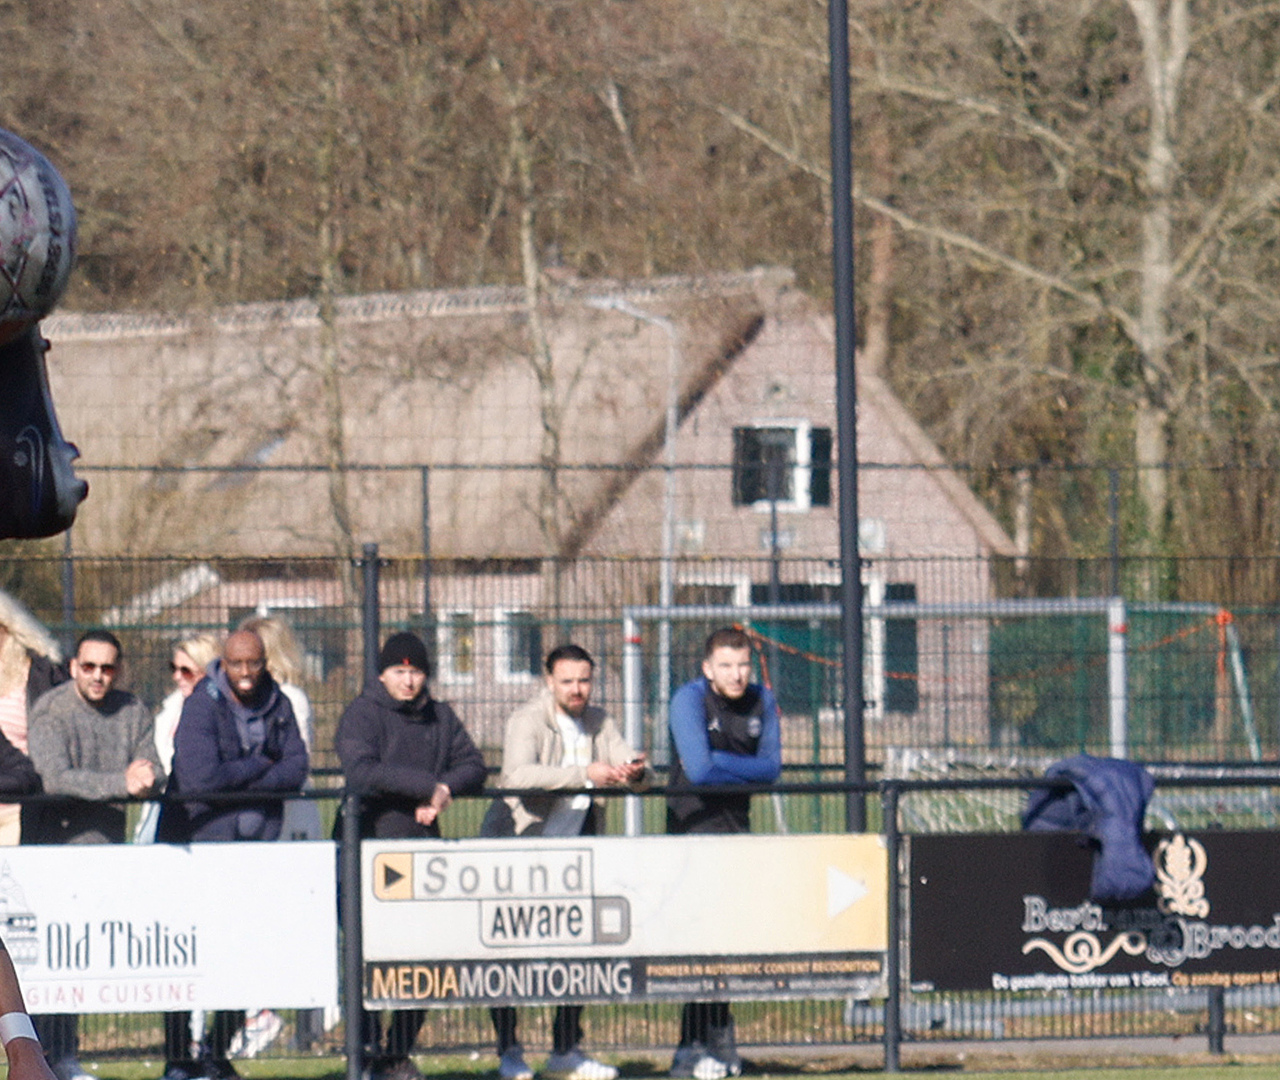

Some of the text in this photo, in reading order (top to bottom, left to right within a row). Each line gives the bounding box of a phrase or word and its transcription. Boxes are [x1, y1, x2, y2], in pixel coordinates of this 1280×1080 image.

[423, 855, 584, 893] Sound
[47, 920, 197, 971] Old Tbilisi
[98, 983, 197, 1004] CUISINE
[371, 961, 633, 999] MEDIAMONITORING
